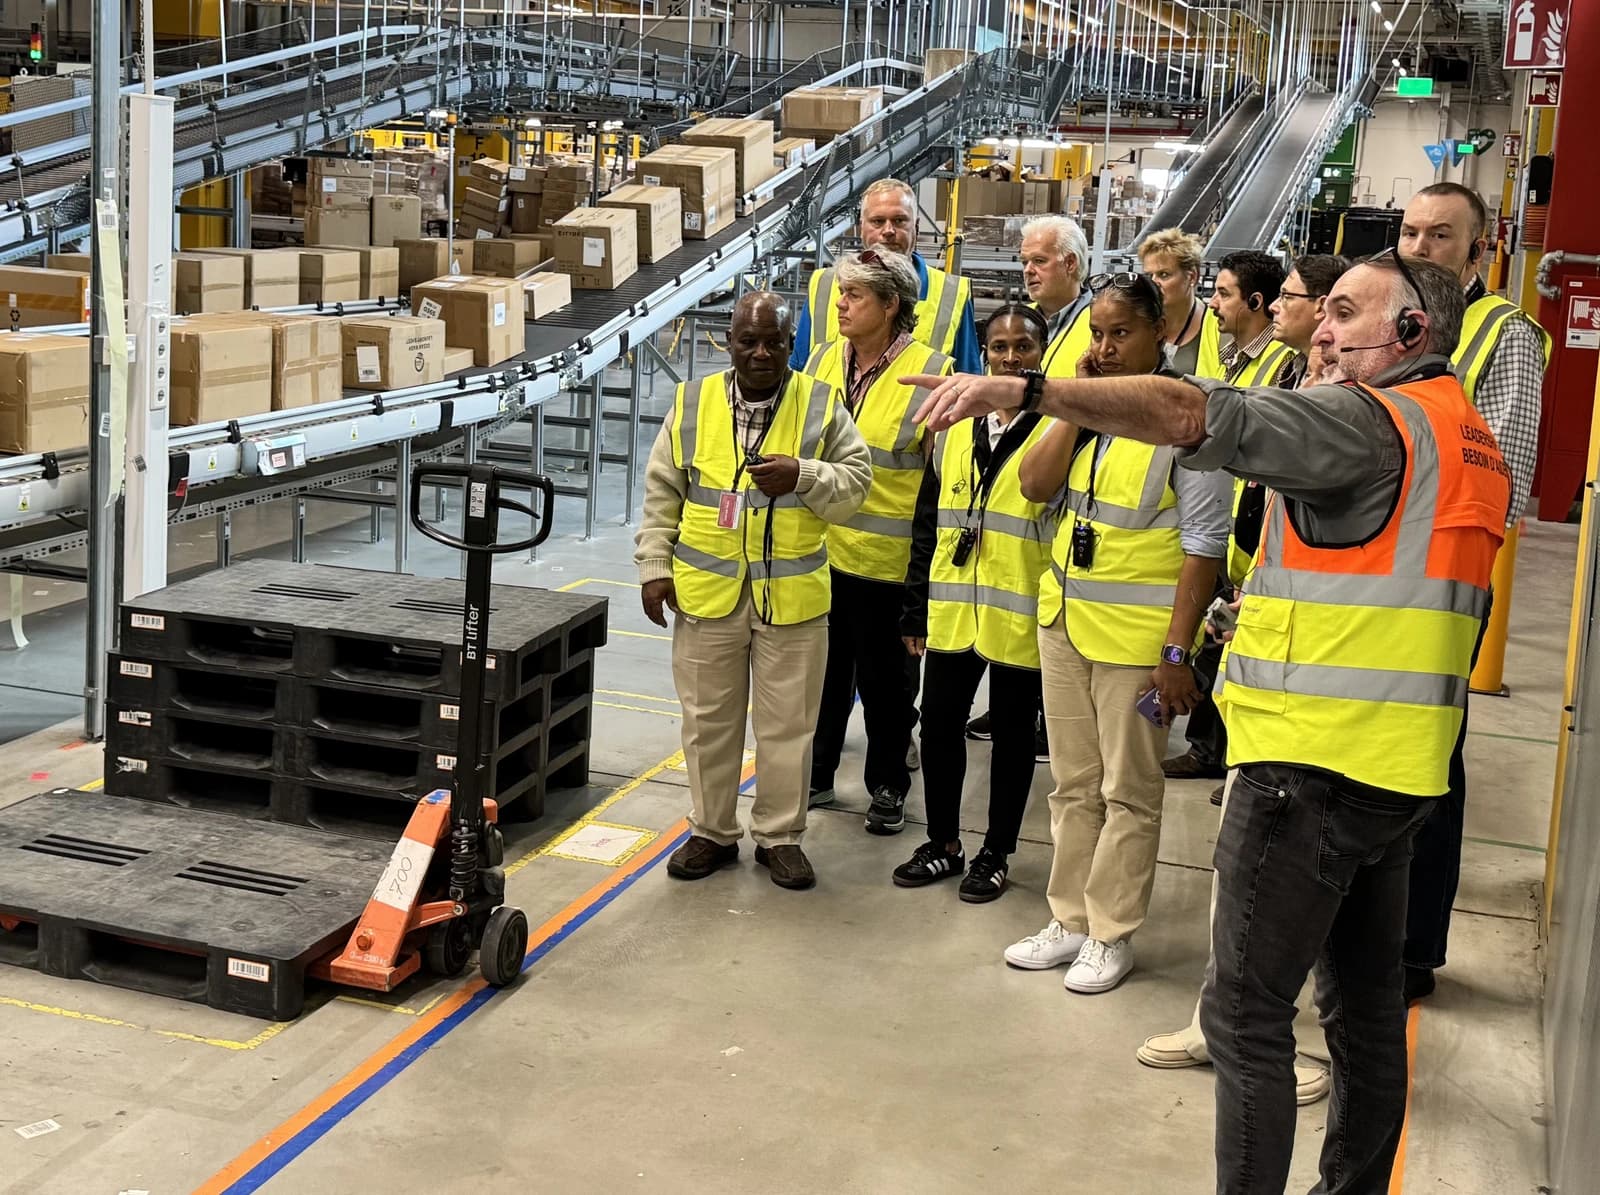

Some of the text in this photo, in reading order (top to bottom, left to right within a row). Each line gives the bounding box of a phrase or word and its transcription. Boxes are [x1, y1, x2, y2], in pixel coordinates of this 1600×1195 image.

[475, 136, 484, 151] F
[1461, 447, 1490, 469] BESOIN
[465, 603, 480, 660] BT lifter
[388, 856, 413, 896] 700
